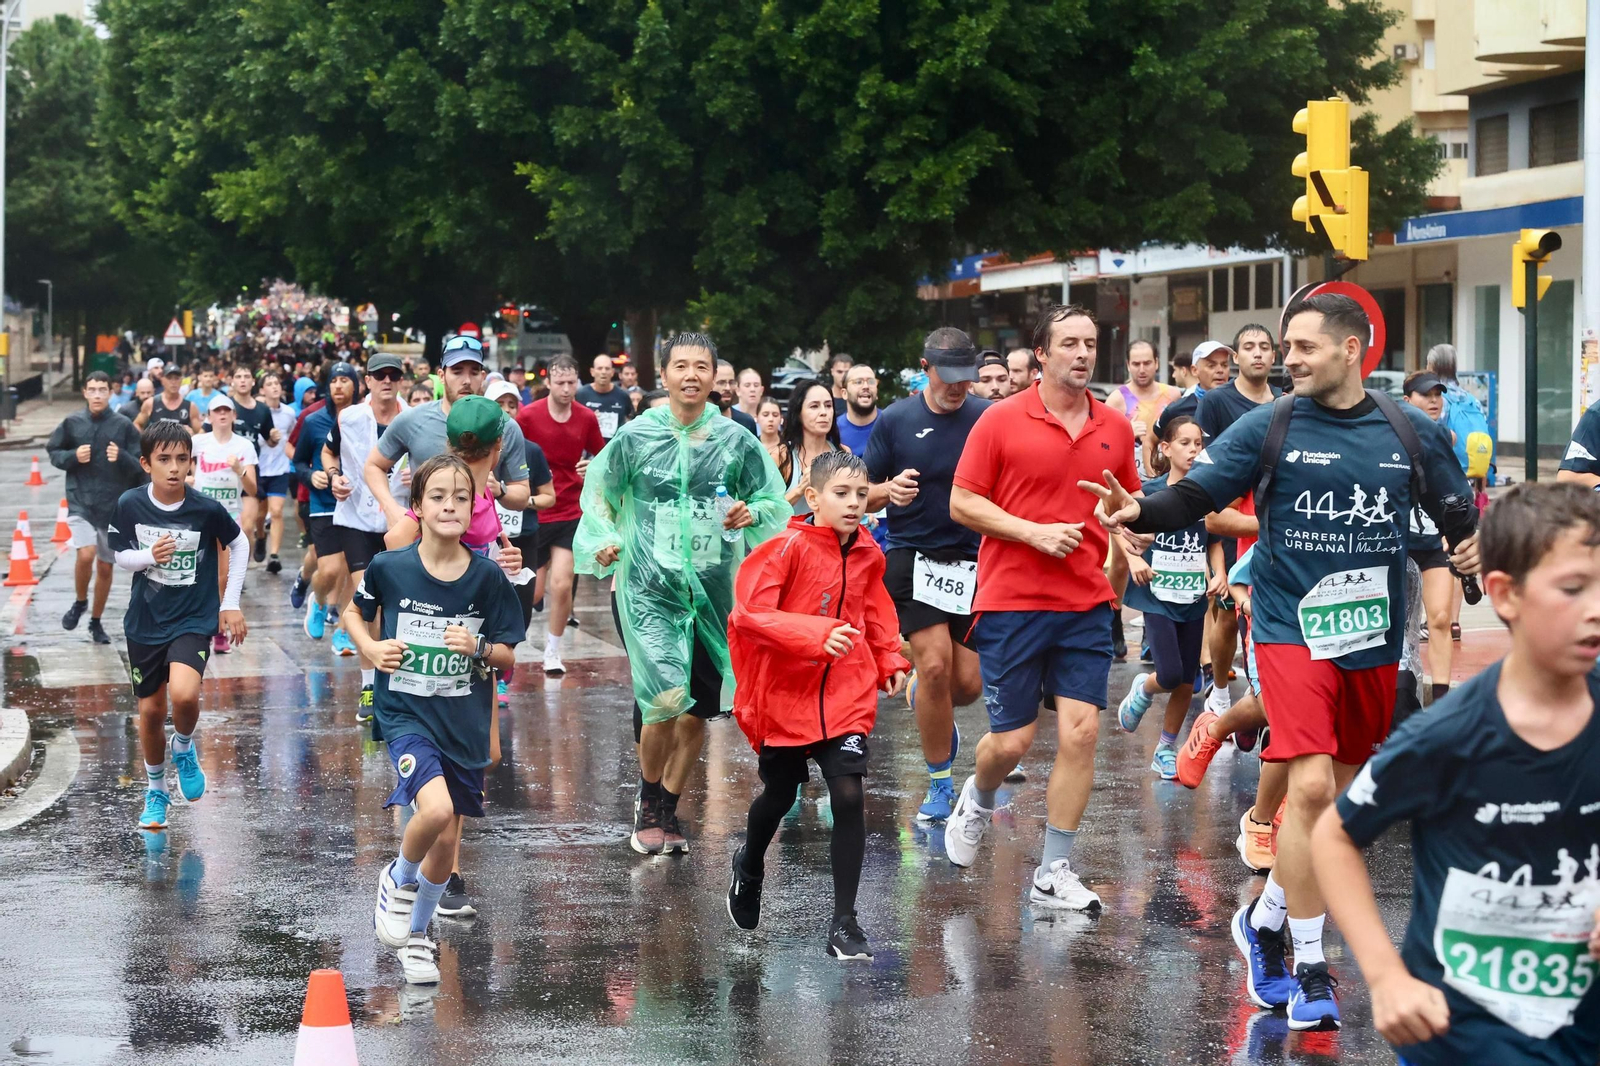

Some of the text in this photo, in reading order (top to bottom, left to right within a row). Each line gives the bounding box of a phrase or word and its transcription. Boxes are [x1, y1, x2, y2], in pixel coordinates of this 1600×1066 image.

[1303, 450, 1341, 460] Fundación
[1303, 456, 1331, 466] Unicaja
[1285, 528, 1346, 542] CARRERA
[1357, 531, 1395, 541] Ciudad
[1285, 539, 1346, 553] URBANA
[925, 573, 965, 597] 7458
[1155, 574, 1202, 590] 22324
[412, 600, 443, 612] Fundación
[412, 605, 434, 615] Unicaja
[1307, 604, 1384, 637] 21803
[400, 649, 469, 675] 21069
[1501, 799, 1561, 813] Fundación
[1449, 942, 1594, 996] 21835
